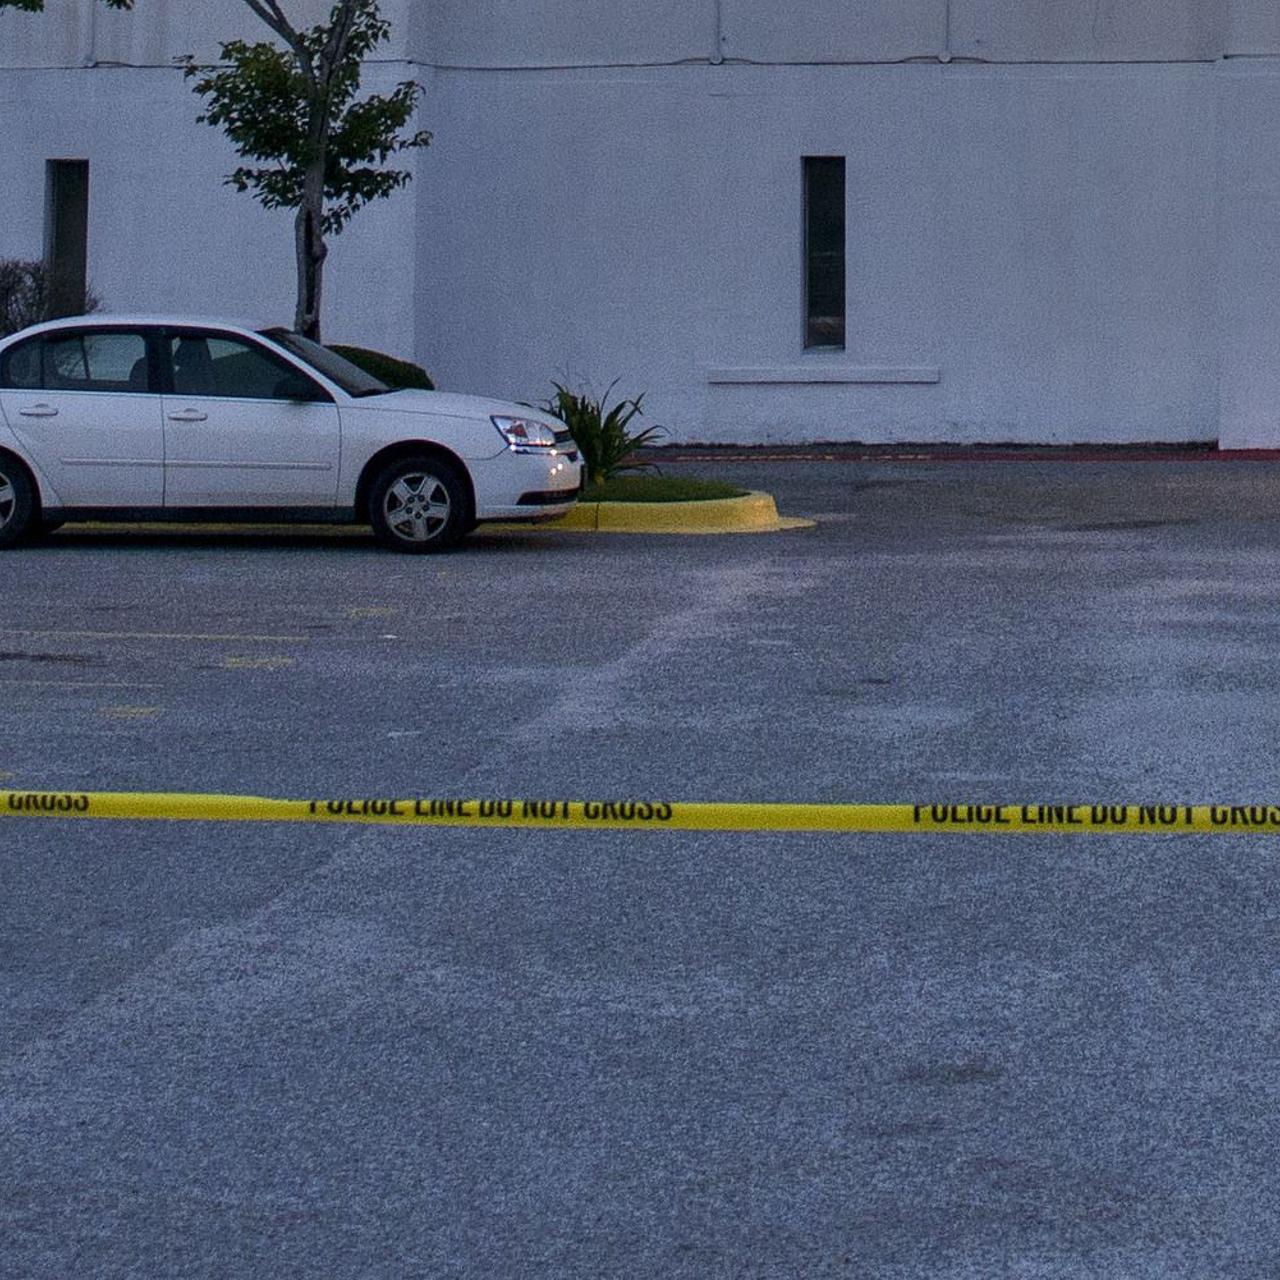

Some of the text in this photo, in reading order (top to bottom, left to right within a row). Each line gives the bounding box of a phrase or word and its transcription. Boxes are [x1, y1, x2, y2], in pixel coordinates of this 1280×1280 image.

[414, 798, 473, 816] LINE
[479, 800, 513, 818] DO
[522, 799, 572, 819] NOT
[583, 801, 673, 820] CROSS
[913, 802, 1011, 823] POLICE
[1021, 804, 1082, 823] LINE
[1091, 806, 1128, 824] DO
[1139, 806, 1194, 824] NOT
